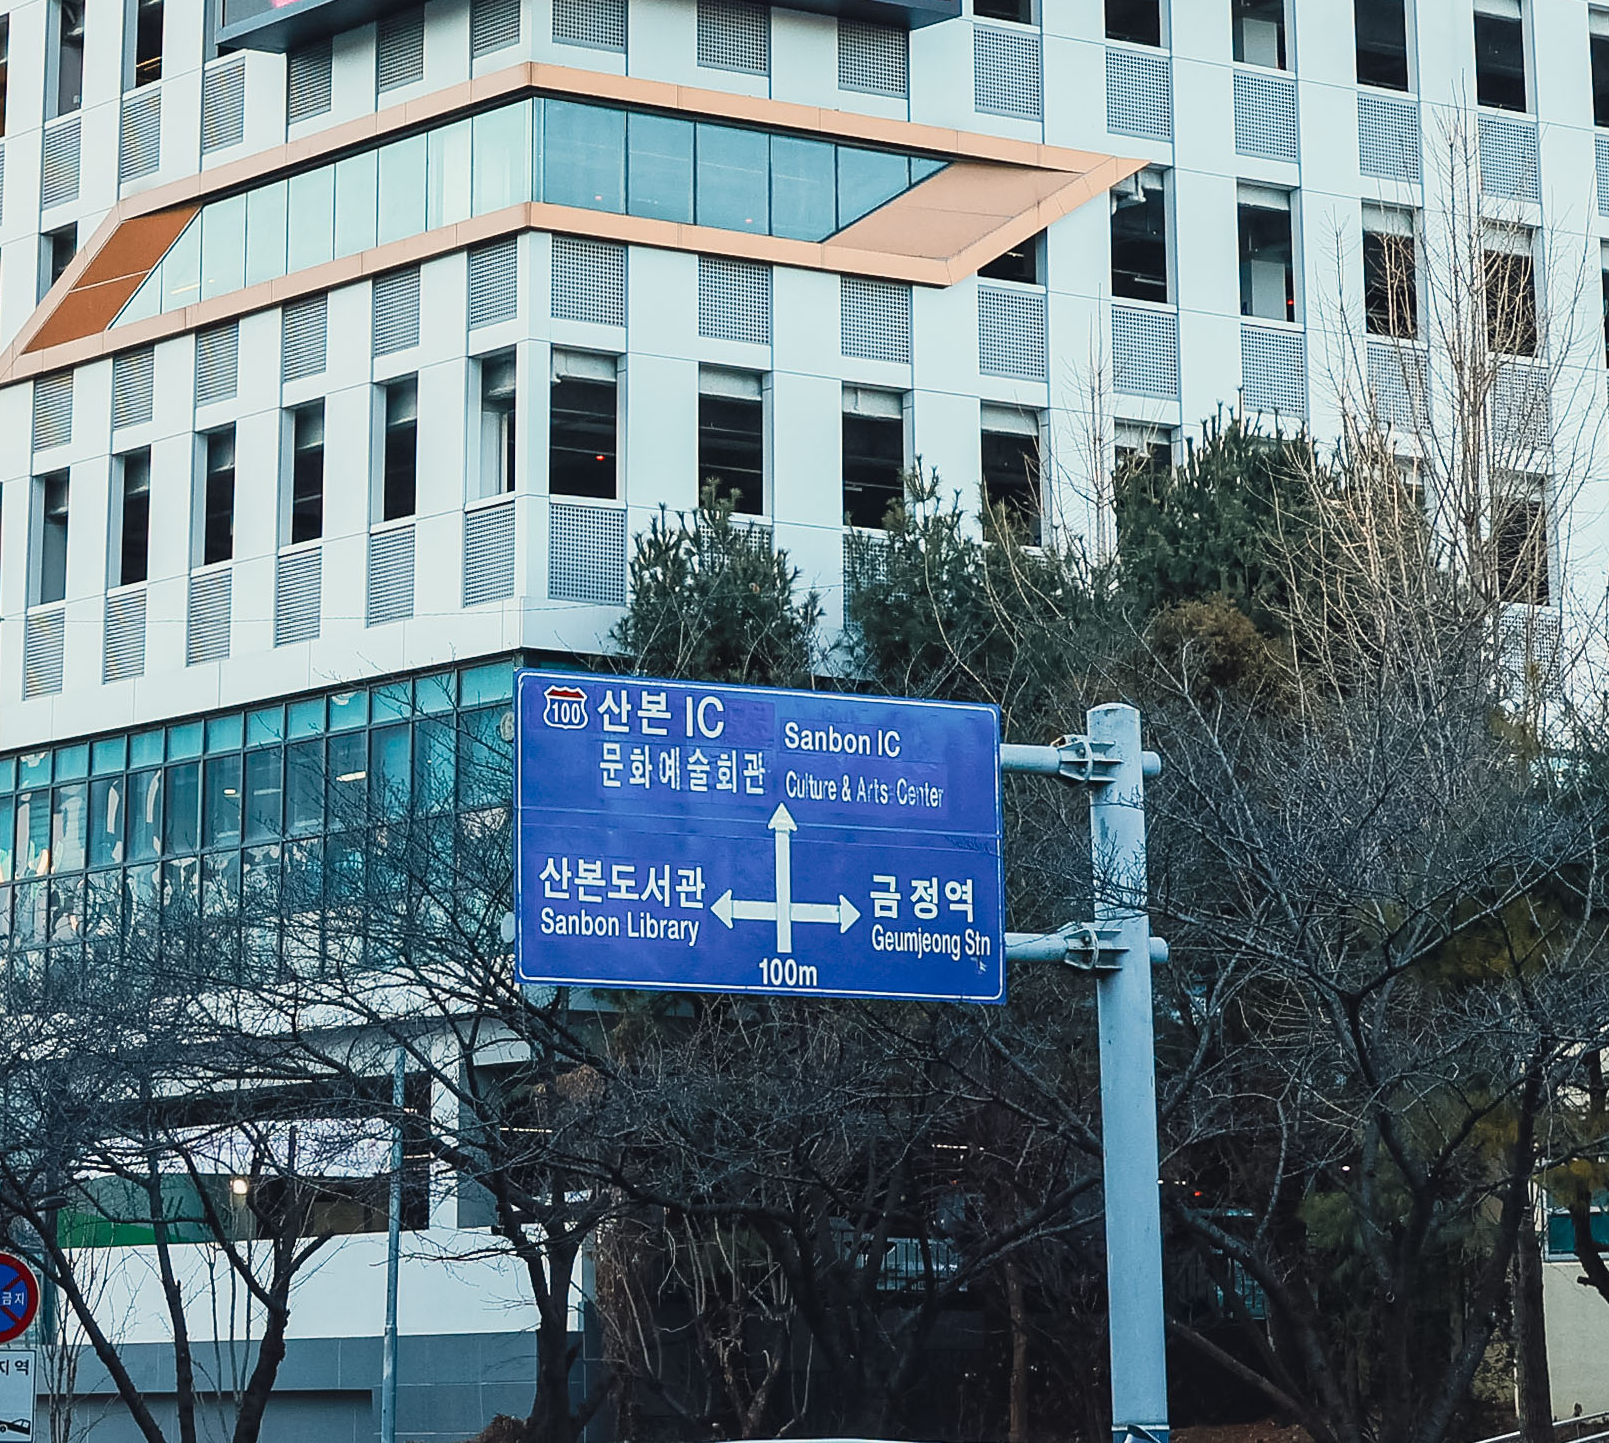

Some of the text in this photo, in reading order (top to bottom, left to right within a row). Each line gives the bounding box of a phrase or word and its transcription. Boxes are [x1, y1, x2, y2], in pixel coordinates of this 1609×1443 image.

[551, 701, 581, 725] 100
[597, 689, 725, 739] 산본 IC
[784, 721, 901, 758] Sanbon IC
[599, 742, 766, 795] 문화예술회관
[785, 770, 944, 808] Culture & Arts Center
[539, 857, 706, 909] 산본도서관
[870, 874, 974, 923] 금정역
[540, 907, 700, 947] Sanbon Library
[871, 923, 990, 961] Geumjeong Stn
[758, 957, 818, 987] 100m
